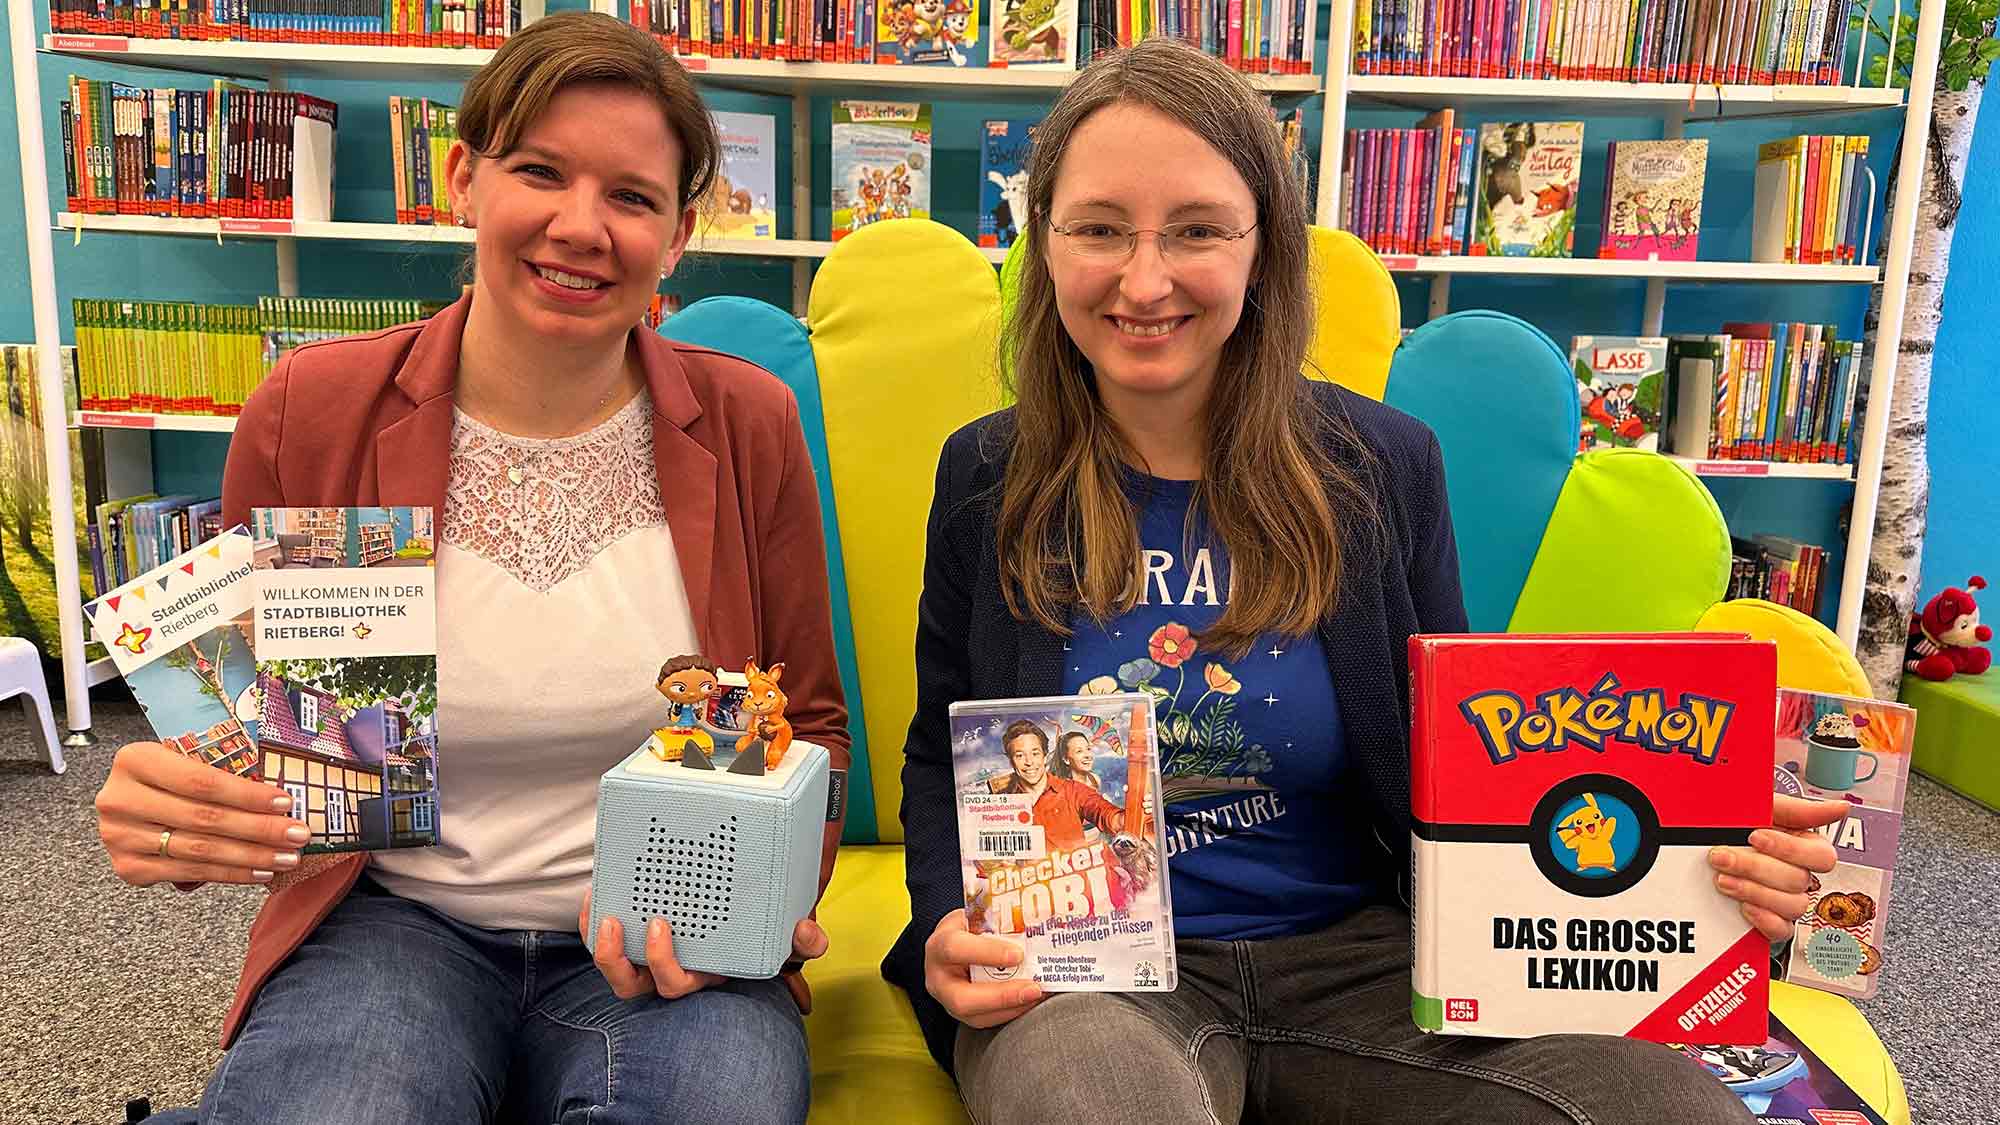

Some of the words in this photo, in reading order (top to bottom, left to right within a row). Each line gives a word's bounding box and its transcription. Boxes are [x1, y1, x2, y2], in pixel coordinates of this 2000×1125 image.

[1541, 147, 1572, 180] Tag
[1592, 346, 1646, 370] LASSE
[263, 585, 370, 601] WILLKOMMEN
[374, 586, 389, 598] IN
[394, 585, 424, 598] DER
[160, 602, 219, 638] Rietberg
[263, 604, 407, 620] STADTBIBLIOTHEK
[264, 626, 345, 640] RIETBERG!
[830, 777, 842, 819] toniebox
[965, 796, 981, 804] DVD
[982, 796, 991, 804] 24
[991, 866, 1114, 934] TOBI
[1025, 922, 1045, 938] und
[1065, 914, 1097, 931] Reise
[1099, 915, 1110, 926] zu
[1051, 927, 1110, 949] fliegenden
[1112, 920, 1153, 936] Flüssen
[1492, 917, 1557, 950] DAS
[1566, 918, 1696, 954] GROSSE
[1826, 933, 1841, 944] 40
[1042, 965, 1053, 973] mit
[1054, 964, 1079, 973] Checker
[1079, 964, 1091, 973] Tobi
[1067, 955, 1097, 965] Abenteuer
[1527, 957, 1659, 992] LEXIKON
[1450, 1001, 1474, 1011] NEL
[1677, 962, 1758, 1032] OFFIZIELLES
[1707, 991, 1748, 1026] PRODUKT
[1450, 1011, 1475, 1021] SON
